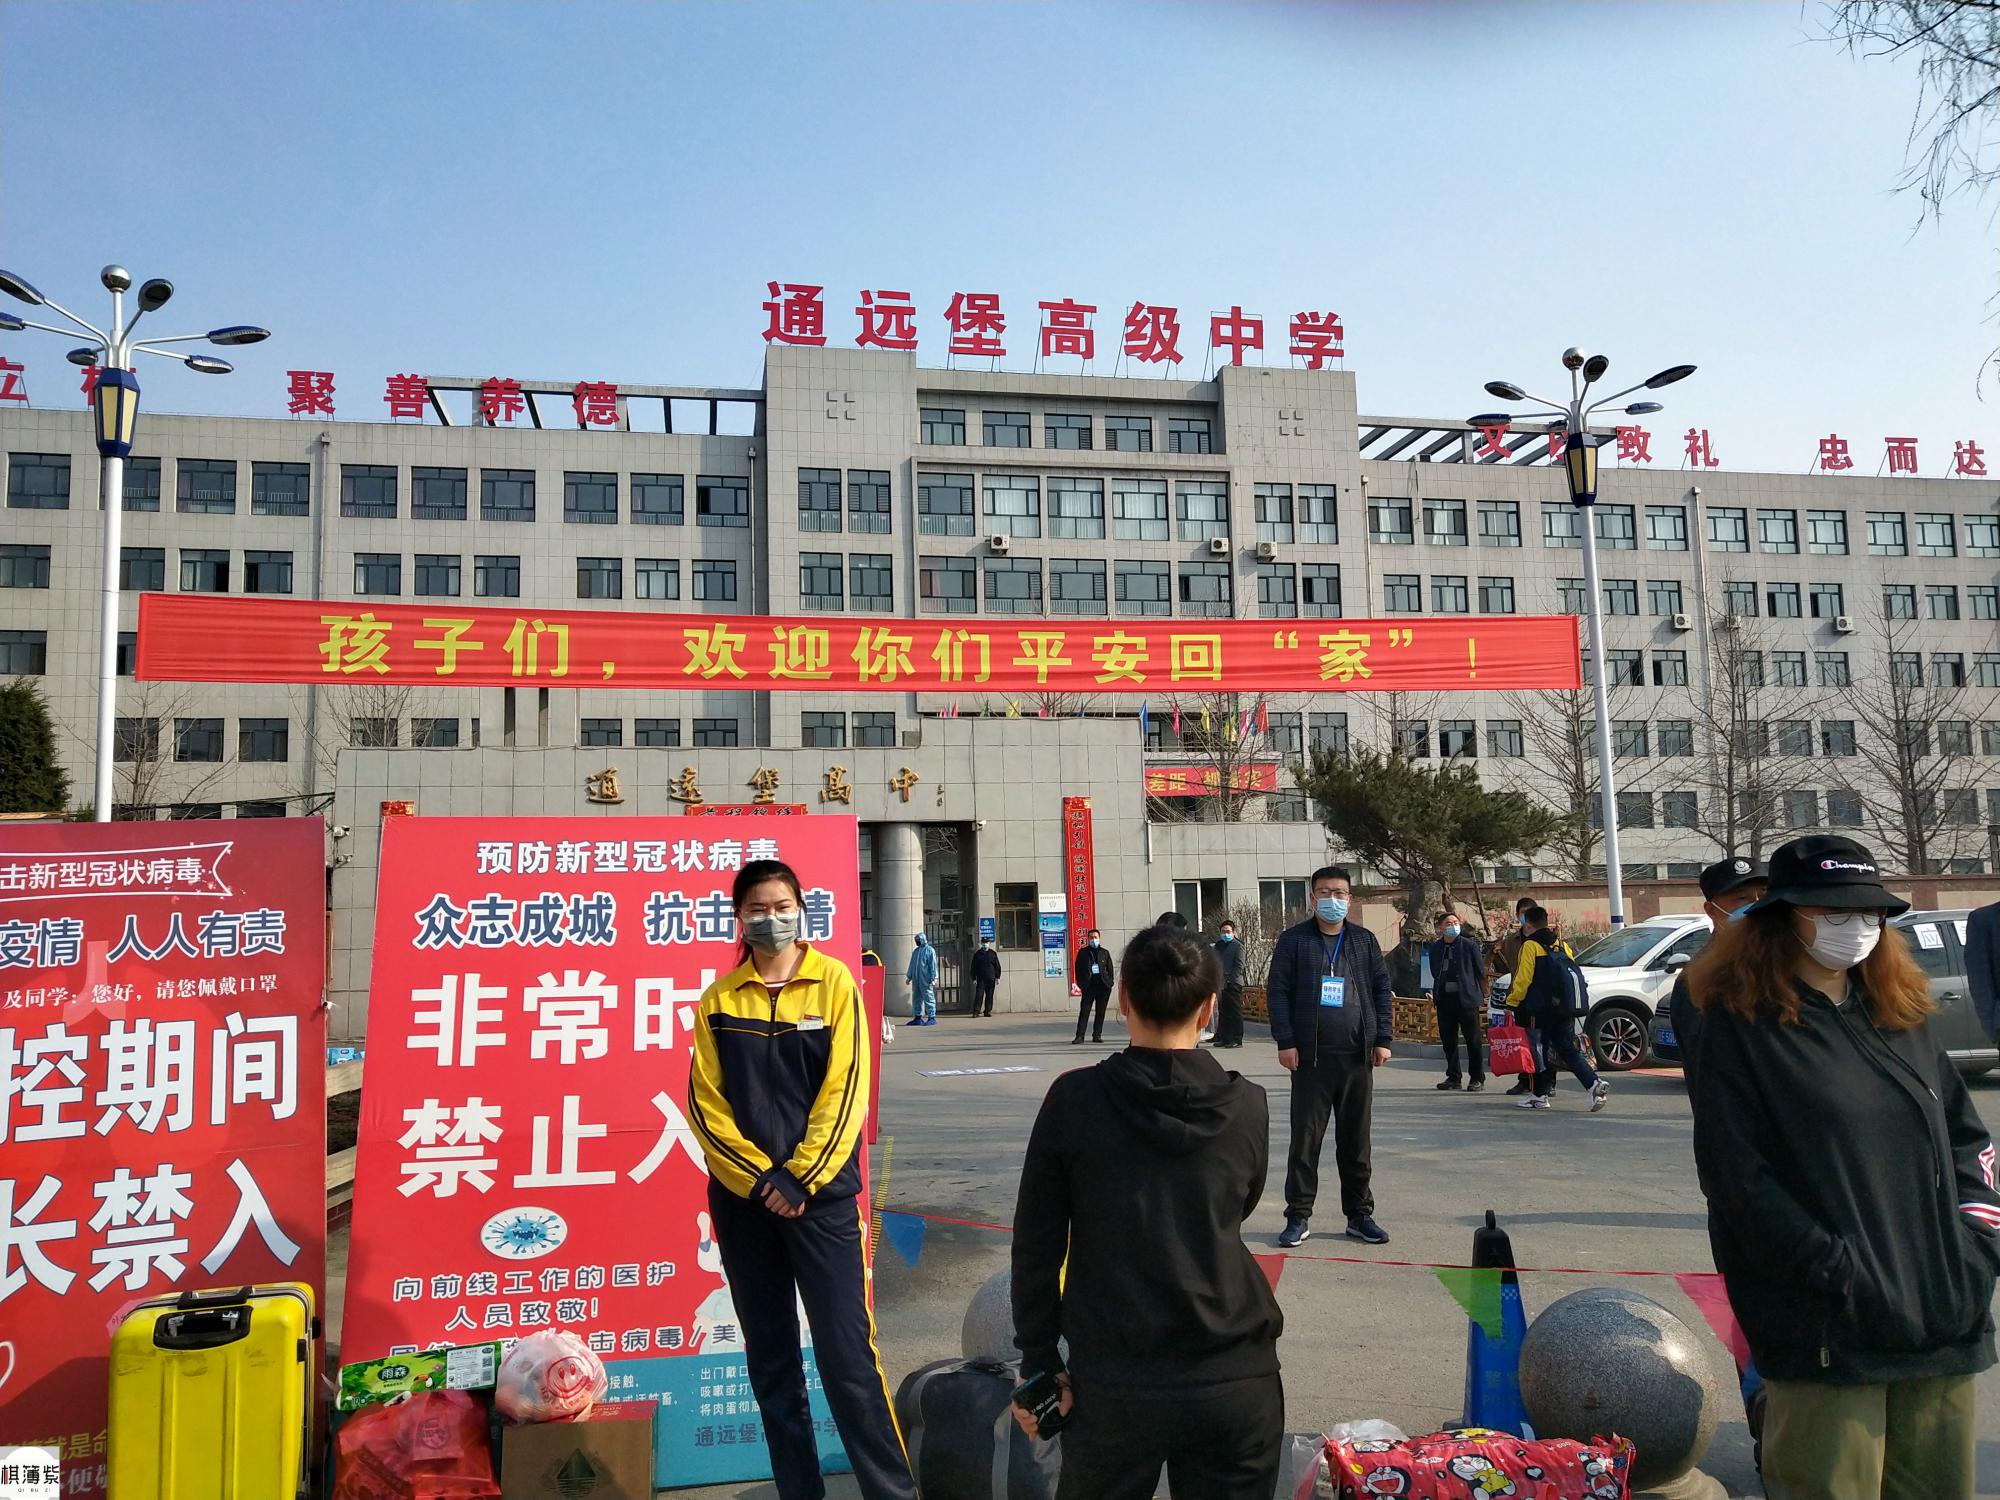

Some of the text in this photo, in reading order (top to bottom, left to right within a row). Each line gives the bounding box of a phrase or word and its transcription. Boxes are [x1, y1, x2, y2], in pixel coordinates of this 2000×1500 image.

[762, 281, 1345, 370] 通远堡高级中学
[286, 369, 621, 425] 聚善养德
[0, 856, 203, 891] 击新型冠状病毒
[476, 837, 780, 875] 预防新型冠状病毒
[412, 887, 836, 950] 众志成城 抗击情
[0, 907, 287, 970] 疫情 人人有责
[393, 1261, 675, 1302] 向前线工作的医护
[444, 1298, 600, 1331] 人员致敬！
[381, 1365, 408, 1380] 雨森
[694, 1422, 766, 1447] 通远堡
